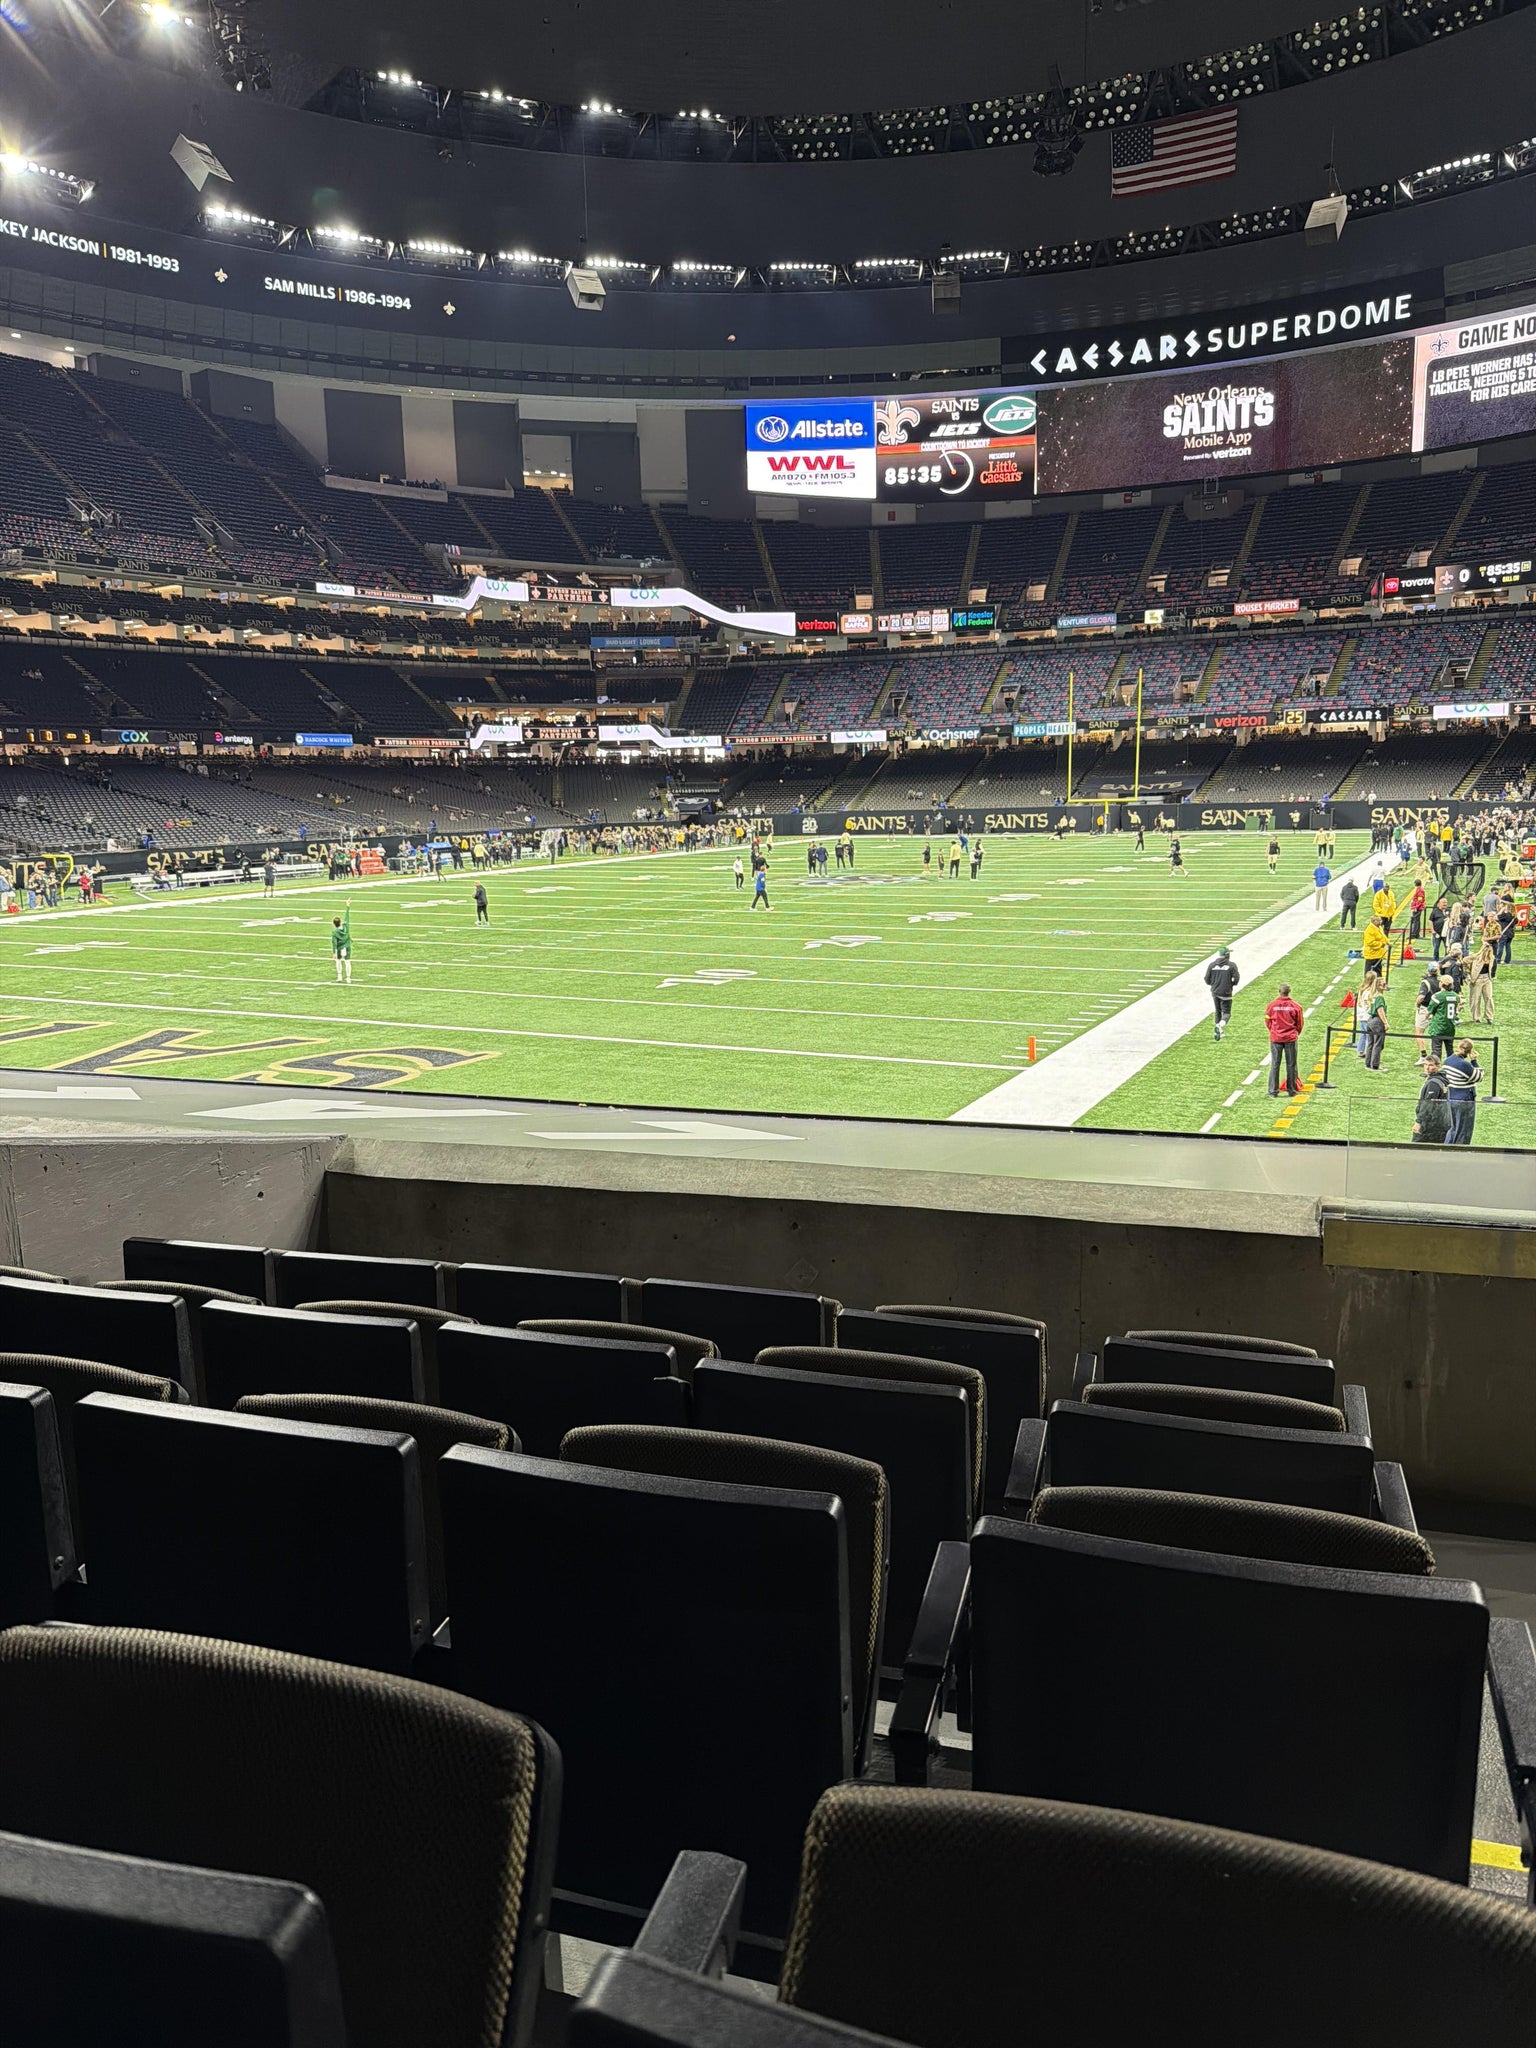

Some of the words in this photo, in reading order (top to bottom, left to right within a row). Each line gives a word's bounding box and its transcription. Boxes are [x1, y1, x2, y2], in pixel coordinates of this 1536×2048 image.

[31, 227, 100, 257] JACKSON
[109, 245, 180, 273] 1981-1993
[264, 276, 295, 294] SAM
[296, 282, 336, 300] MILLS
[344, 289, 412, 310] 1986-1994
[1029, 329, 1201, 376] CAESARS
[1207, 293, 1412, 353] SUPERDOME
[1458, 321, 1509, 350] GAME
[1432, 369, 1445, 384] LB
[1446, 365, 1470, 381] PETE
[1470, 357, 1511, 377] WERNER
[1512, 352, 1533, 369] HAS
[1428, 379, 1473, 397] TACKLES,
[1473, 369, 1517, 389] NEEDING
[1518, 367, 1525, 380] 5
[1172, 391, 1206, 407] New
[1208, 384, 1265, 401] Orleans
[1470, 387, 1490, 403] FOR
[1490, 385, 1510, 400] HIS
[931, 398, 980, 414] SAINTS
[989, 404, 1036, 423] JETS
[1162, 391, 1275, 438] SAINTS
[929, 422, 982, 438] JETS
[1183, 433, 1224, 450] Mobile
[1225, 431, 1252, 447] App
[1212, 446, 1252, 460] verizon
[767, 455, 855, 472] WWL
[987, 460, 1018, 474] Little
[884, 464, 942, 486] 85:35
[979, 471, 1024, 484] Caesars
[42, 549, 78, 562] SAINTS
[117, 559, 150, 571] SAINTS
[1487, 561, 1521, 577] 85:35
[187, 567, 218, 579] SAINTS
[1459, 568, 1470, 583] 0
[252, 575, 282, 587] SAINTS
[1401, 577, 1434, 588] TOYOTA
[547, 593, 593, 602] PARTNERS
[630, 589, 660, 600] COX
[1330, 594, 1362, 604] SAINTS
[51, 601, 84, 612] SAINTS
[119, 607, 150, 618] SAINTS
[1195, 605, 1225, 615] SAINTS
[1235, 603, 1263, 614] ROUSES
[1263, 600, 1298, 612] MARKETS
[184, 613, 213, 624] SAINTS
[246, 619, 274, 628] SAINTS
[797, 619, 837, 631] verizon
[917, 617, 930, 625] 150
[968, 618, 993, 626] Federal
[1022, 619, 1051, 628] SAINTS
[1058, 617, 1089, 626] VENTURE
[1089, 615, 1115, 625] GLOBAL
[305, 623, 332, 633] SAINTS
[361, 628, 388, 637] SAINTS
[416, 632, 442, 641] SAINTS
[473, 635, 500, 644] SAINTS
[531, 637, 559, 645] SAINTS
[1319, 710, 1382, 722] CAESARS
[1393, 705, 1430, 716] SAINTS
[1088, 719, 1120, 729] SAINTS
[1157, 716, 1190, 726] SAINTS
[1213, 714, 1267, 728] verizon
[1286, 711, 1303, 724] 25
[889, 729, 917, 738] SAINTS
[929, 728, 980, 741] Ochsner
[1014, 725, 1046, 736] PEOPLES
[1047, 723, 1075, 735] HEALTH
[120, 731, 149, 744] COX
[168, 733, 198, 742] SAINTS
[224, 736, 253, 745] entergy
[1100, 781, 1183, 791] SAINTS
[985, 813, 1049, 830] SAINTS
[1370, 806, 1450, 825] SAINTS
[846, 815, 907, 832] SAINTS
[1447, 1003, 1455, 1019] 8
